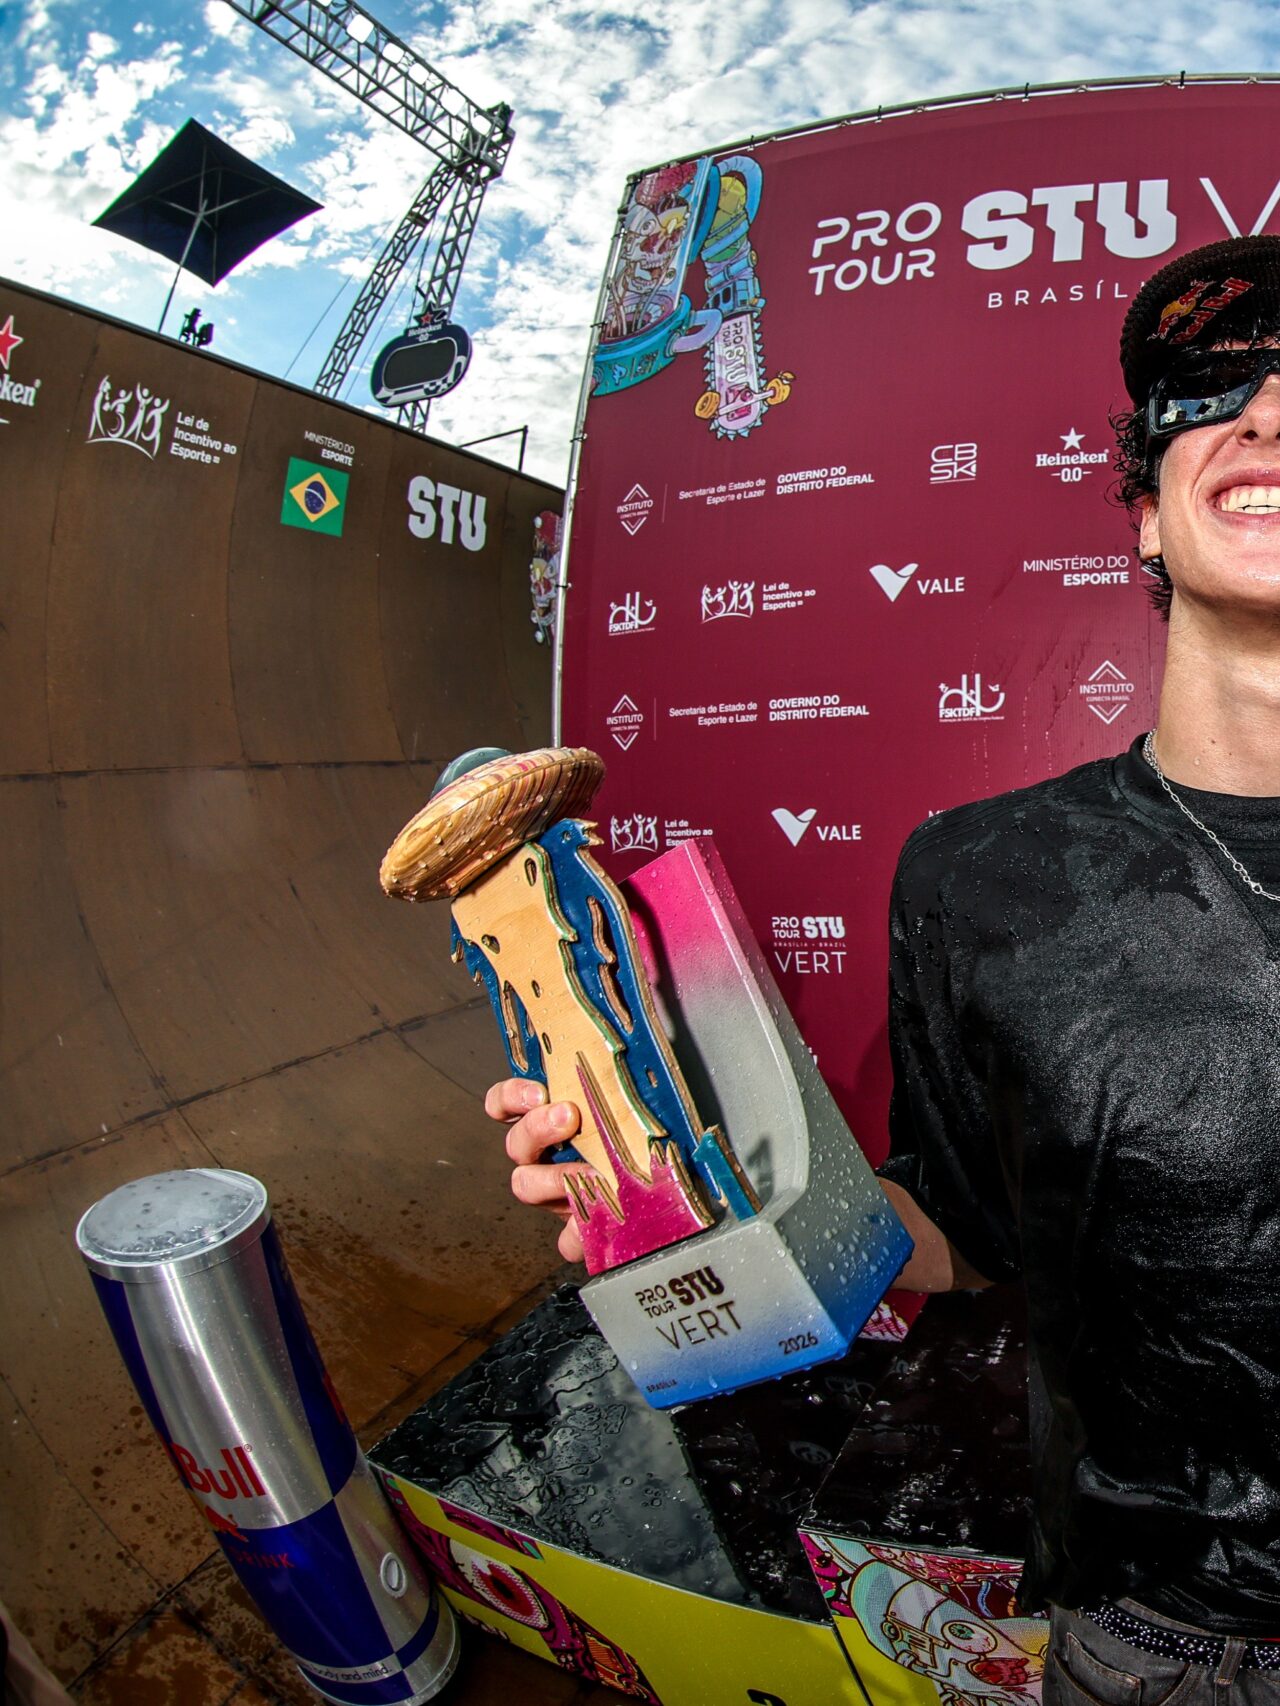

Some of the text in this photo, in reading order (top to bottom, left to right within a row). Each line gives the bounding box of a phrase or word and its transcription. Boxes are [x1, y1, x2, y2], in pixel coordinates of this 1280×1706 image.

[812, 201, 942, 258] PRO
[961, 179, 1177, 270] STU
[808, 248, 936, 296] TOUR
[988, 280, 1145, 308] BRASÍL
[408, 322, 443, 337] Heineken
[721, 324, 732, 348] TOUR
[732, 321, 744, 344] PRO
[725, 346, 748, 384] STU
[177, 412, 209, 432] Lei de
[174, 427, 237, 455] Incentivo ao
[304, 430, 355, 455] MINISTÉRIO DO
[170, 443, 212, 464] Esporte
[321, 449, 353, 466] ESPORTE
[1035, 449, 1109, 467] Heineken
[777, 465, 847, 484] GOVERNO DO
[679, 477, 766, 500] Secretaria de Estado de
[776, 473, 875, 495] DISTRITO FEDERAL
[706, 488, 766, 505] Esporte e Lazer
[408, 475, 487, 552] STU
[617, 500, 653, 513] INSTITUTO
[1023, 554, 1129, 572] MINISTÉRIO DO
[763, 582, 789, 592] Lei de
[917, 577, 965, 595] VALE
[1063, 572, 1129, 586] ESPORTE
[763, 589, 816, 601] Incentivo ao
[762, 600, 796, 611] Esporte
[1079, 683, 1134, 694] INSTITUTO
[669, 701, 757, 718] Secretaria de Estado de
[769, 694, 840, 710] GOVERNO DO
[606, 713, 643, 725] INSTITUTO
[698, 716, 728, 727] Esporte
[735, 712, 758, 723] Lazer
[769, 704, 870, 721] DISTRITO FEDERAL
[665, 819, 689, 828] Lei de
[665, 829, 701, 837] Incentivo
[817, 825, 861, 841] VALE
[666, 838, 687, 847] Espo
[771, 916, 799, 928] PRO
[802, 916, 845, 939] STU
[772, 929, 800, 939] TOUR
[774, 951, 847, 974] VERT
[668, 1265, 725, 1306] STU
[635, 1284, 668, 1307] PRO
[644, 1300, 677, 1319] TOUR
[656, 1300, 742, 1350] VERT
[778, 1331, 818, 1355] 2026
[172, 1442, 267, 1499] Bull
